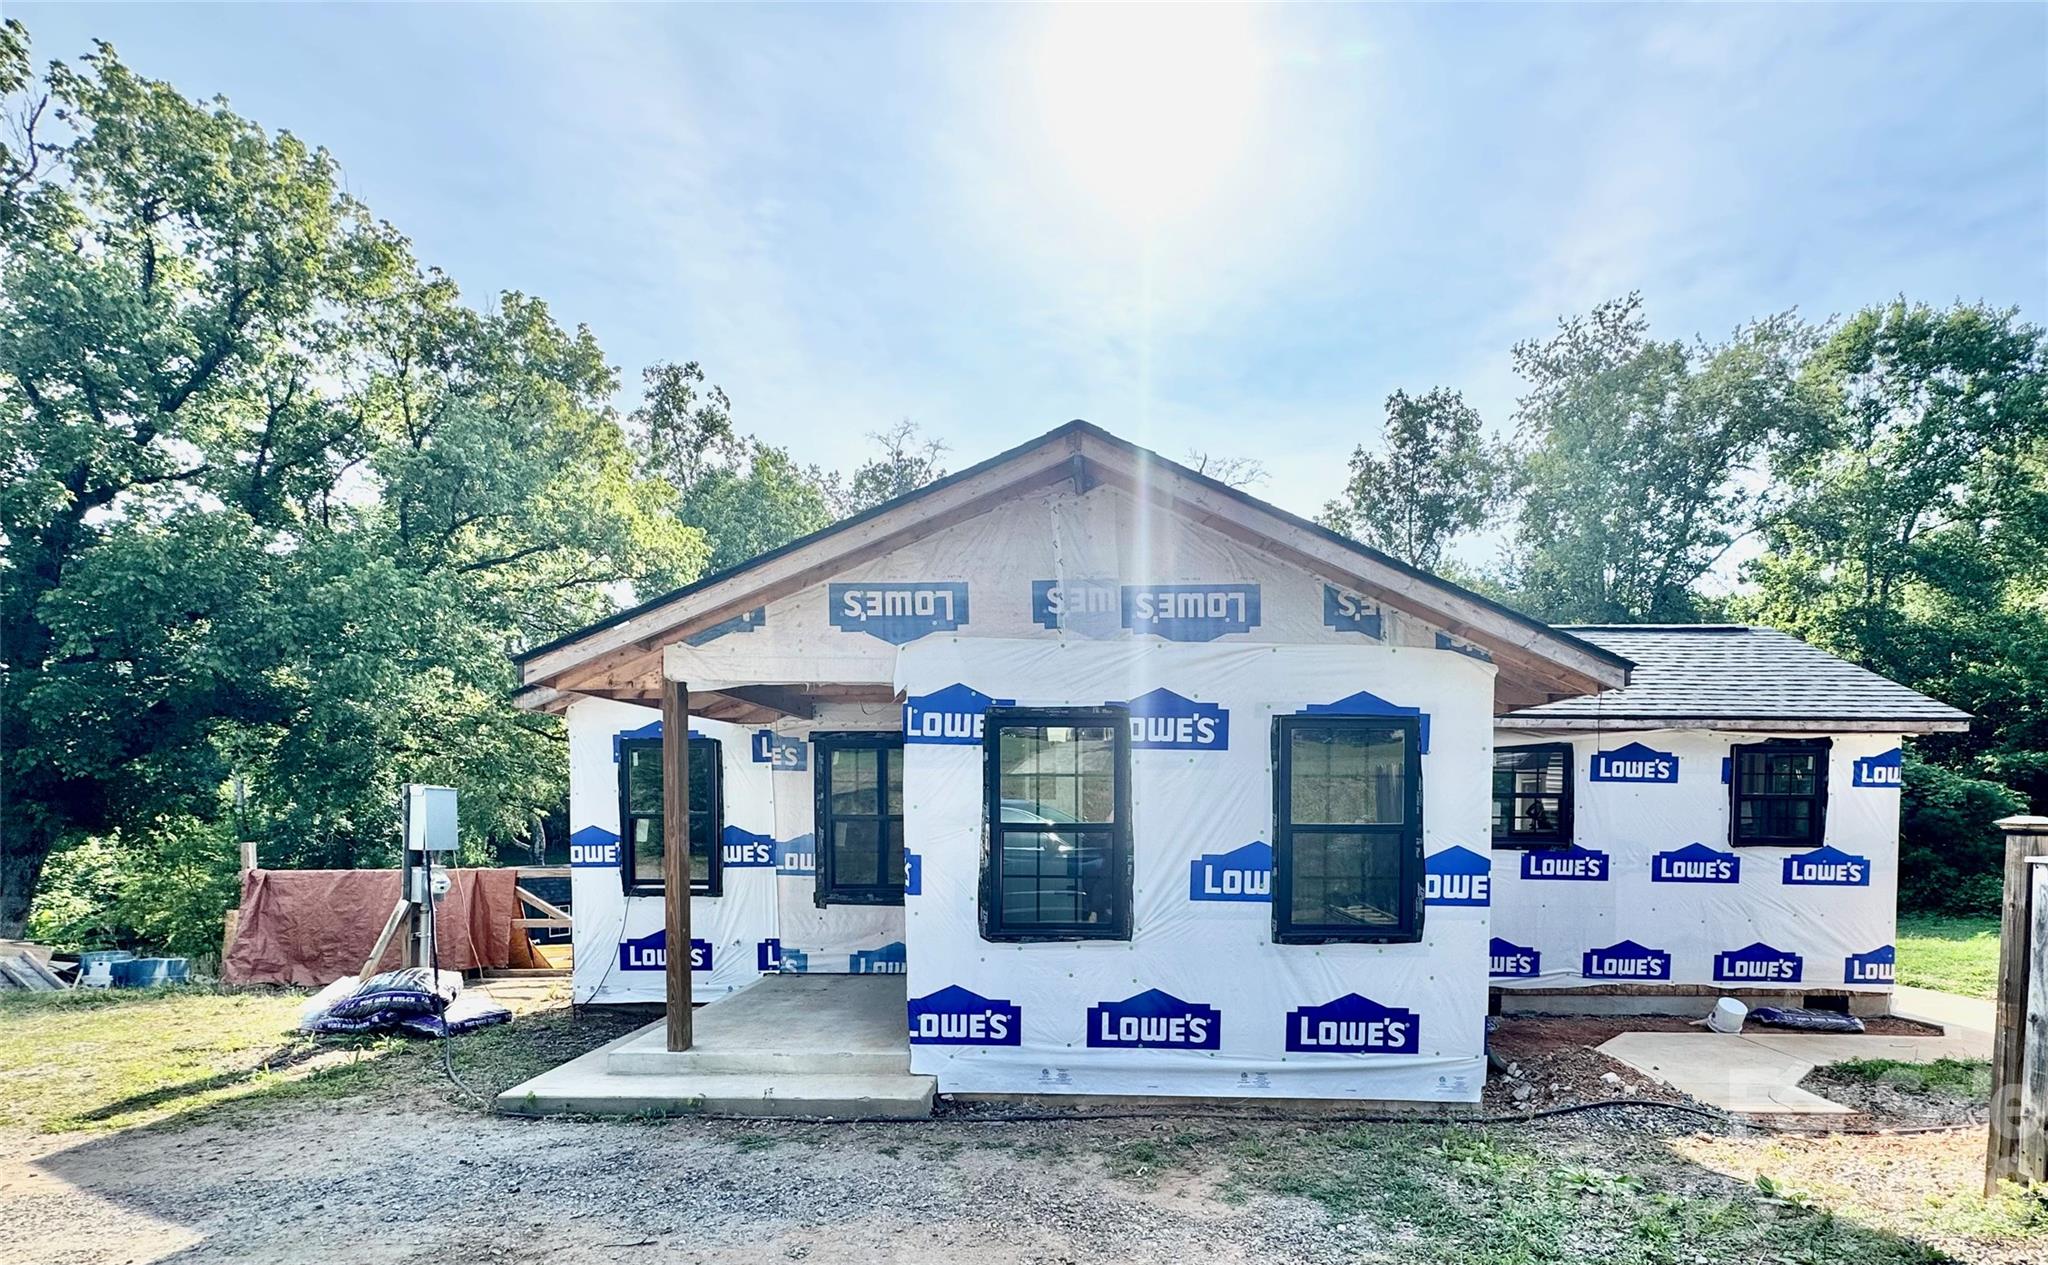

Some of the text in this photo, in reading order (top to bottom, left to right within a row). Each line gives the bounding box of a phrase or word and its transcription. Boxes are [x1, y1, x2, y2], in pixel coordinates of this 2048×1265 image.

[844, 591, 954, 621] LOWE'S
[1136, 592, 1245, 624] LOWE'S
[907, 706, 985, 738] LOWE
[1129, 713, 1215, 744] OWE'S
[1600, 758, 1670, 779] LOWE'S
[1861, 763, 1901, 783] LOW
[723, 842, 769, 863] WE'S
[1530, 856, 1600, 877] LOWE'S
[1661, 858, 1731, 879] LOWE'S
[1792, 860, 1861, 882] LOWE'S
[1205, 865, 1271, 895] LOW
[1425, 874, 1489, 900] OWE
[1489, 954, 1531, 973] WE'S
[1592, 956, 1661, 976] LOWE'S
[1723, 958, 1793, 978] LOWE'S
[1853, 960, 1895, 979] LOW
[910, 1010, 1008, 1040] OWE'S
[1101, 1011, 1207, 1043] LOWE'S
[1300, 1016, 1406, 1047] LOWE'S
